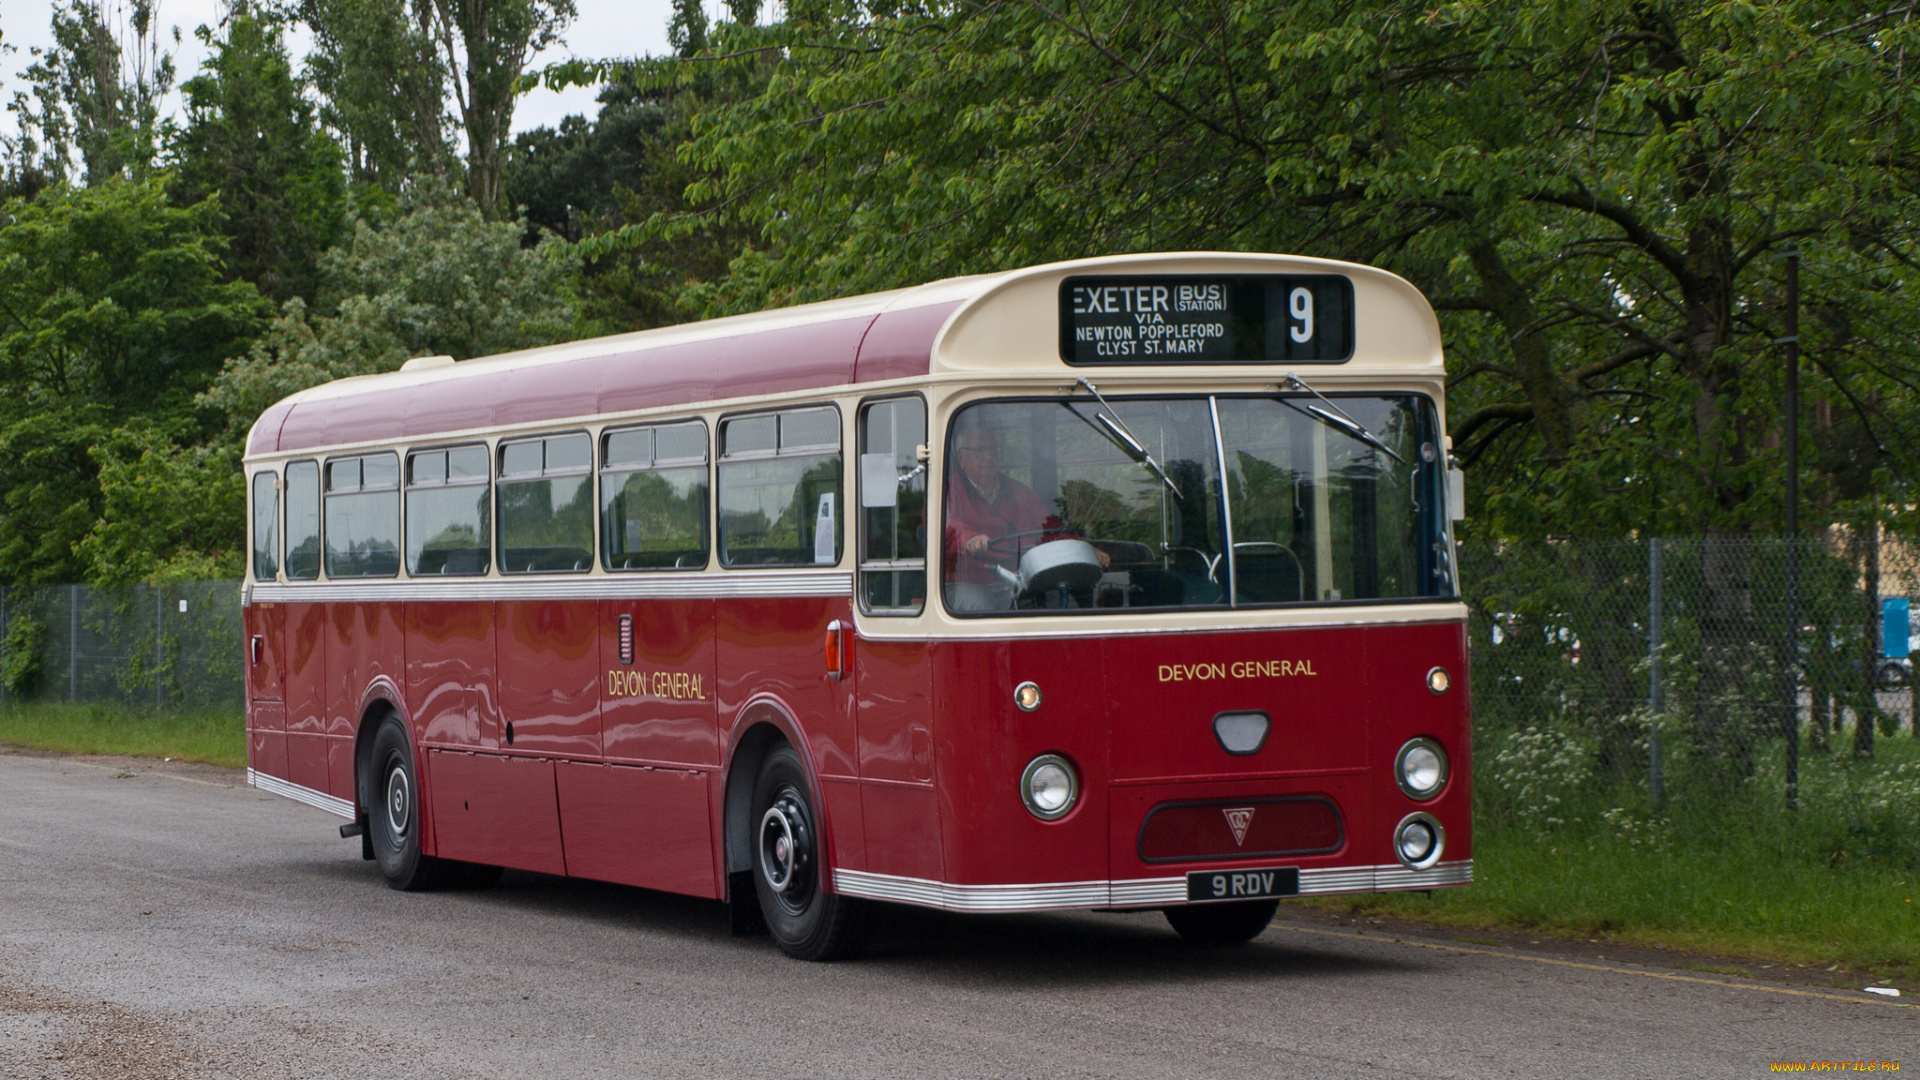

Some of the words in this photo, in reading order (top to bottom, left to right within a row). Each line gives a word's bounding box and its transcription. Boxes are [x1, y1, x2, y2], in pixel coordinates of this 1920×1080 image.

[1073, 286, 1169, 313] EXETER
[1134, 313, 1164, 324] VIA
[1290, 287, 1313, 343] 9
[1076, 326, 1132, 341] NEWTON
[1139, 323, 1224, 339] POPPLEFORD
[1097, 341, 1137, 356] CLYST
[1144, 340, 1163, 354] ST.
[1166, 339, 1204, 353] MARY
[1158, 663, 1226, 682] DEVON
[1230, 659, 1317, 678] GENERAL
[608, 670, 647, 697] DEVON
[652, 671, 705, 700] GENERAL
[1212, 875, 1227, 897] 9
[1232, 872, 1275, 896] RDV
